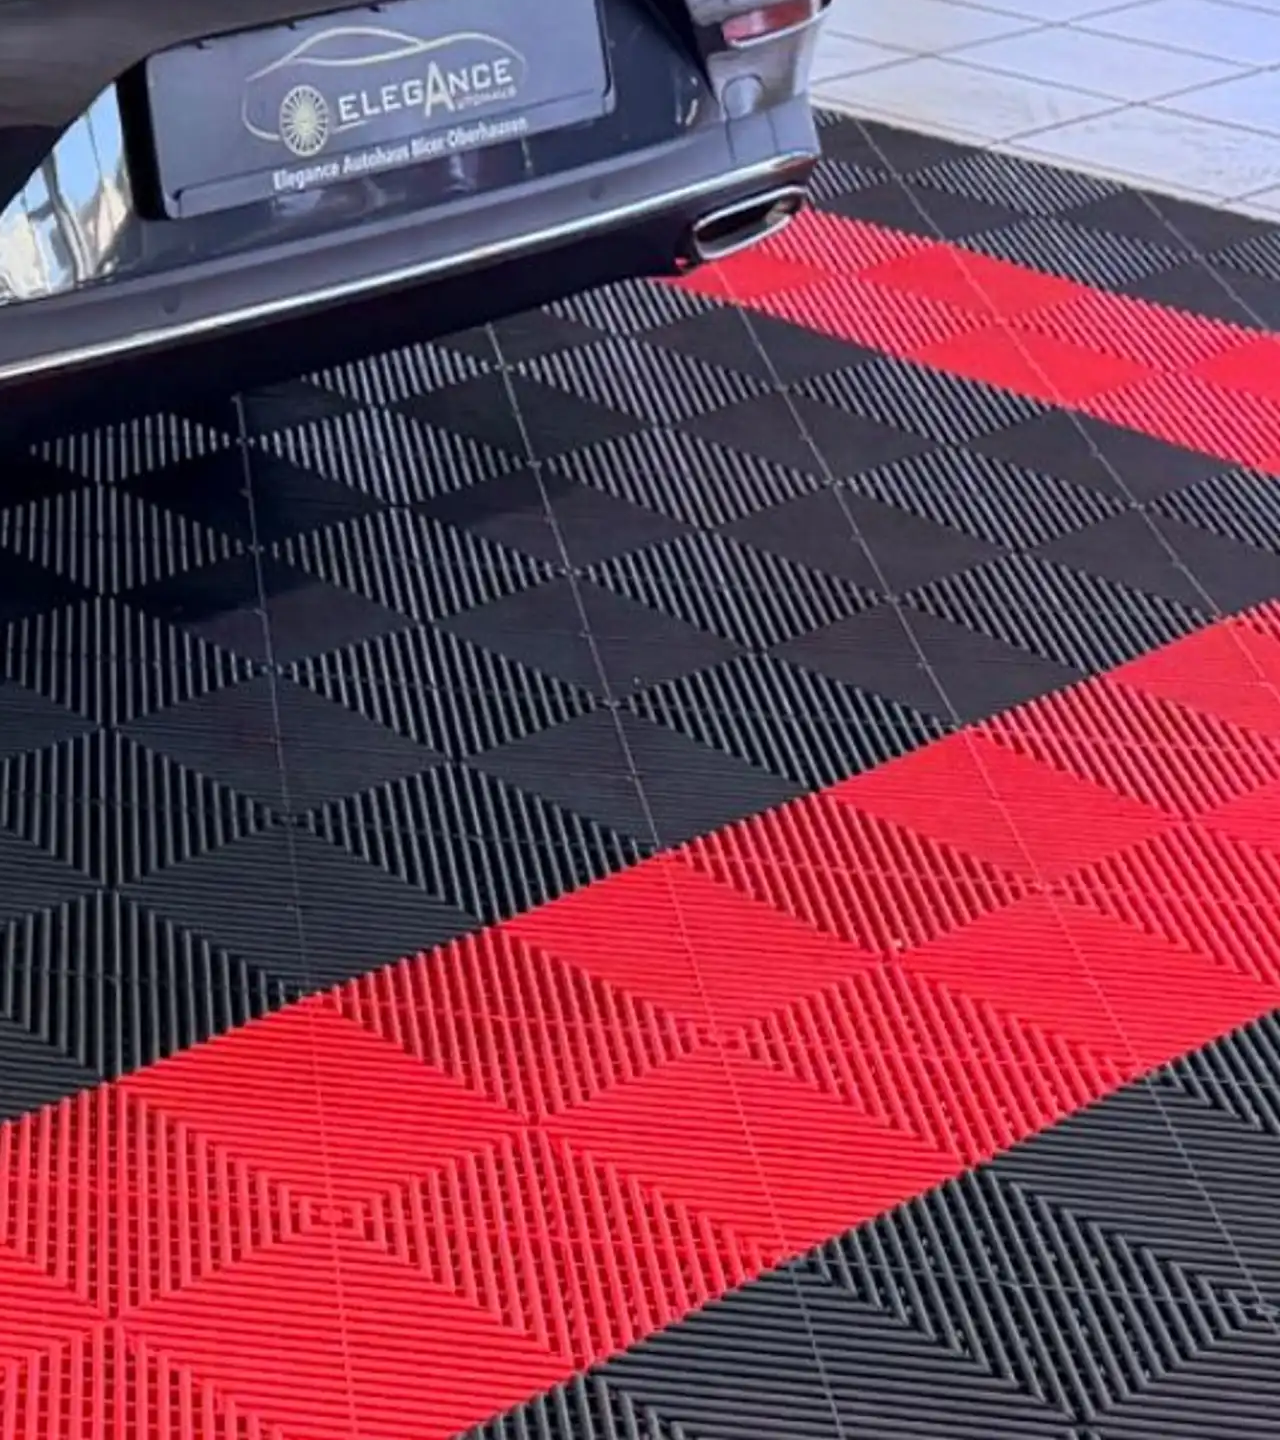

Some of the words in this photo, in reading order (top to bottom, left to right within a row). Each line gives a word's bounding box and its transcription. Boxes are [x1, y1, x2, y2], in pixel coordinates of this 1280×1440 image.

[337, 58, 514, 123] ELEGANCE
[273, 162, 340, 192] Elegance
[343, 143, 410, 174] Autohaus
